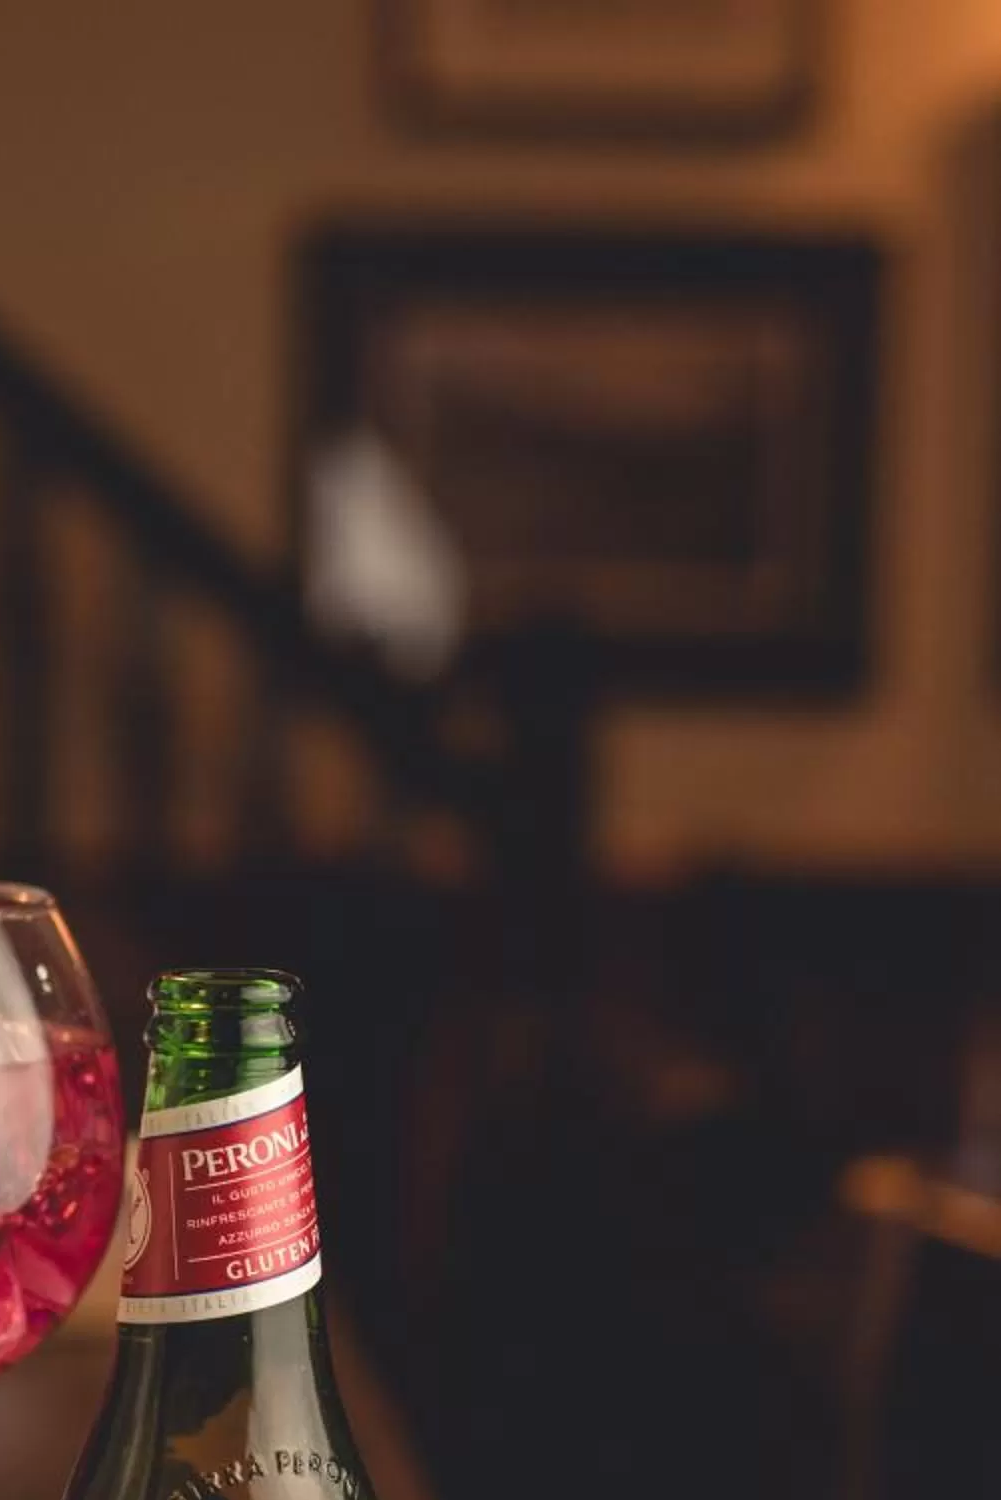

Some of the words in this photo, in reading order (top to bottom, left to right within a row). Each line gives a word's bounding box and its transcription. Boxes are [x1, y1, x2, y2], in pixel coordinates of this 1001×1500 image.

[181, 1122, 299, 1181] PERONI
[212, 1194, 224, 1205] IL
[229, 1180, 276, 1201] GUSTO
[185, 1197, 287, 1229] RINFRESCANTE
[218, 1220, 280, 1246] AZZURRO
[226, 1234, 310, 1280] GLUTEN
